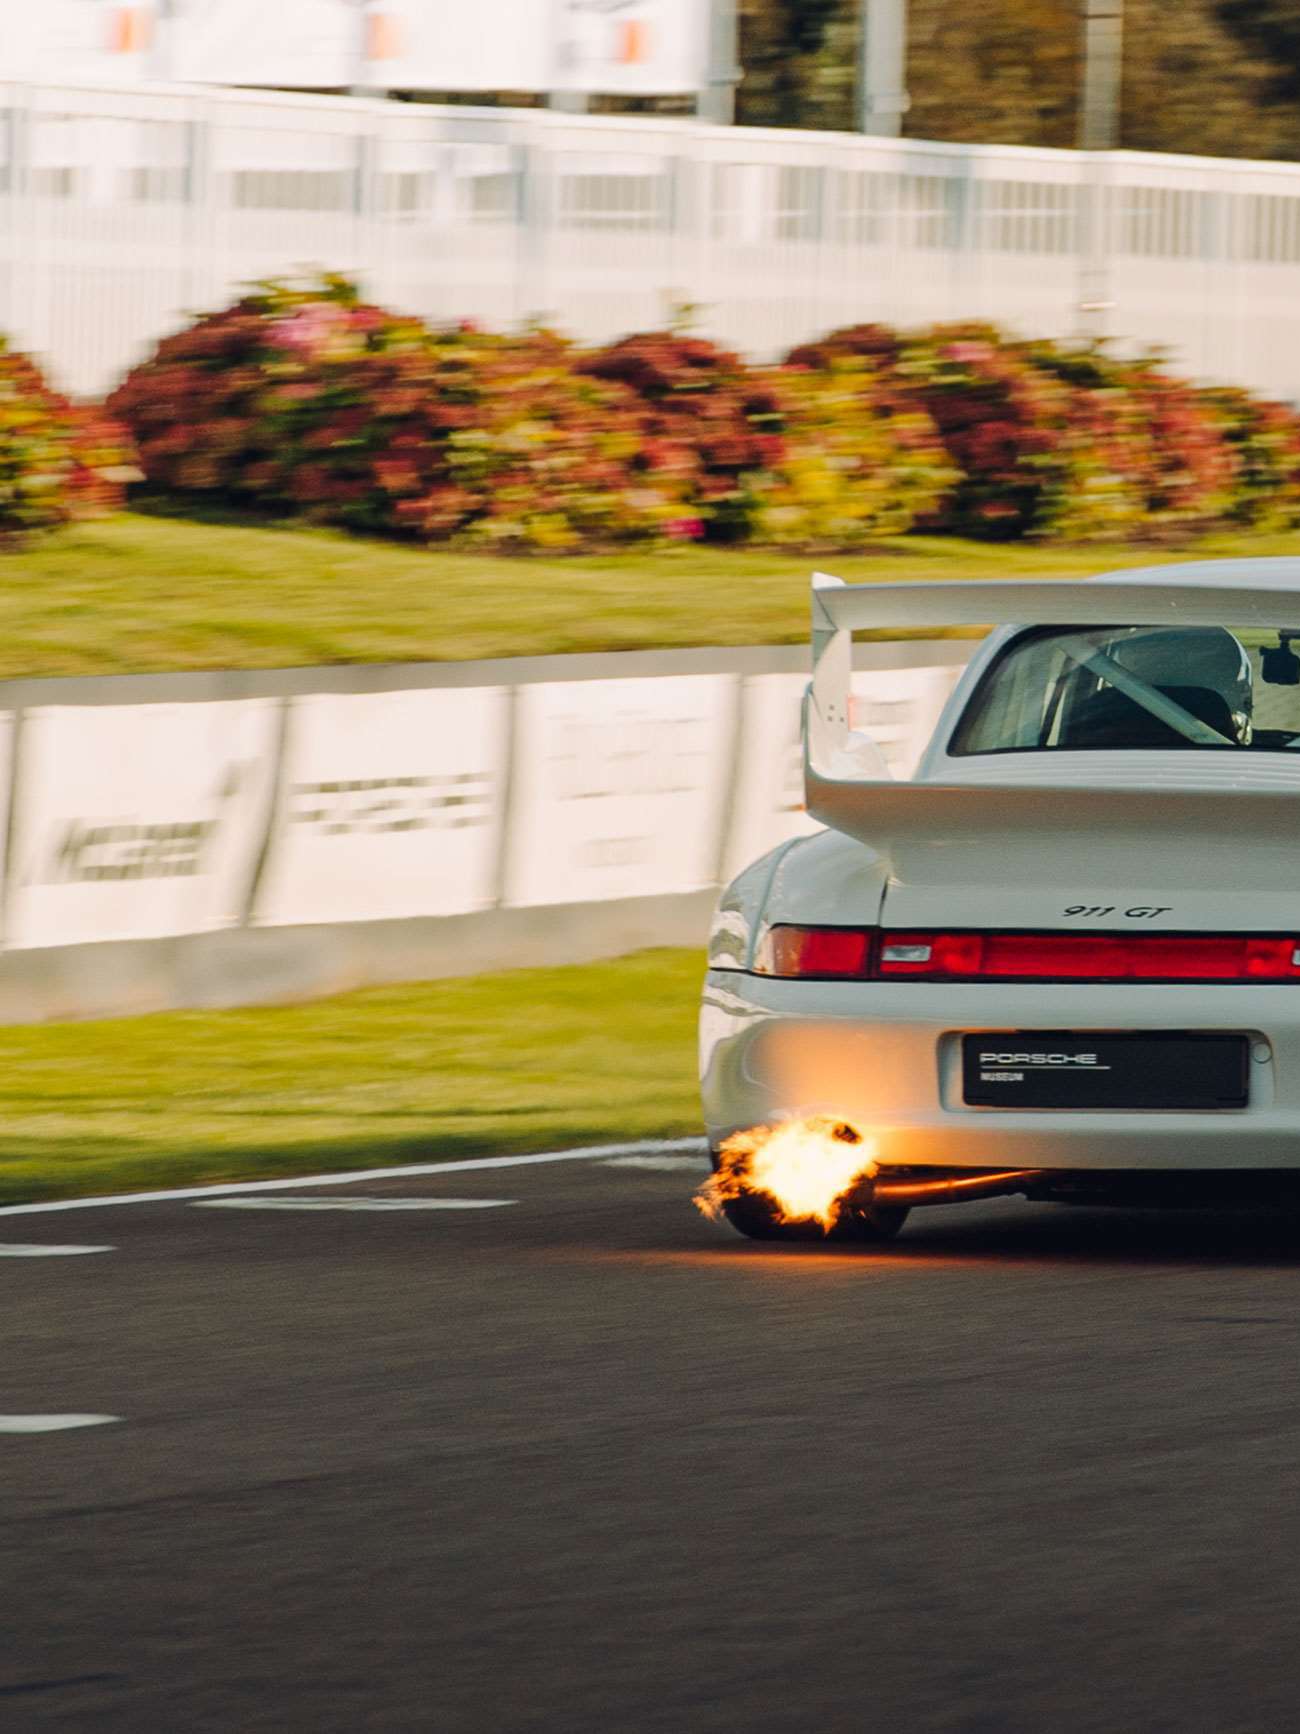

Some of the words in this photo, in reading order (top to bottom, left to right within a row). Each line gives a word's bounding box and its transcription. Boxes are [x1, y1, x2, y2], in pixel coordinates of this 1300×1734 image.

[1062, 905, 1116, 918] 911
[1124, 906, 1174, 919] GT
[979, 1052, 1098, 1065] PORSCHE
